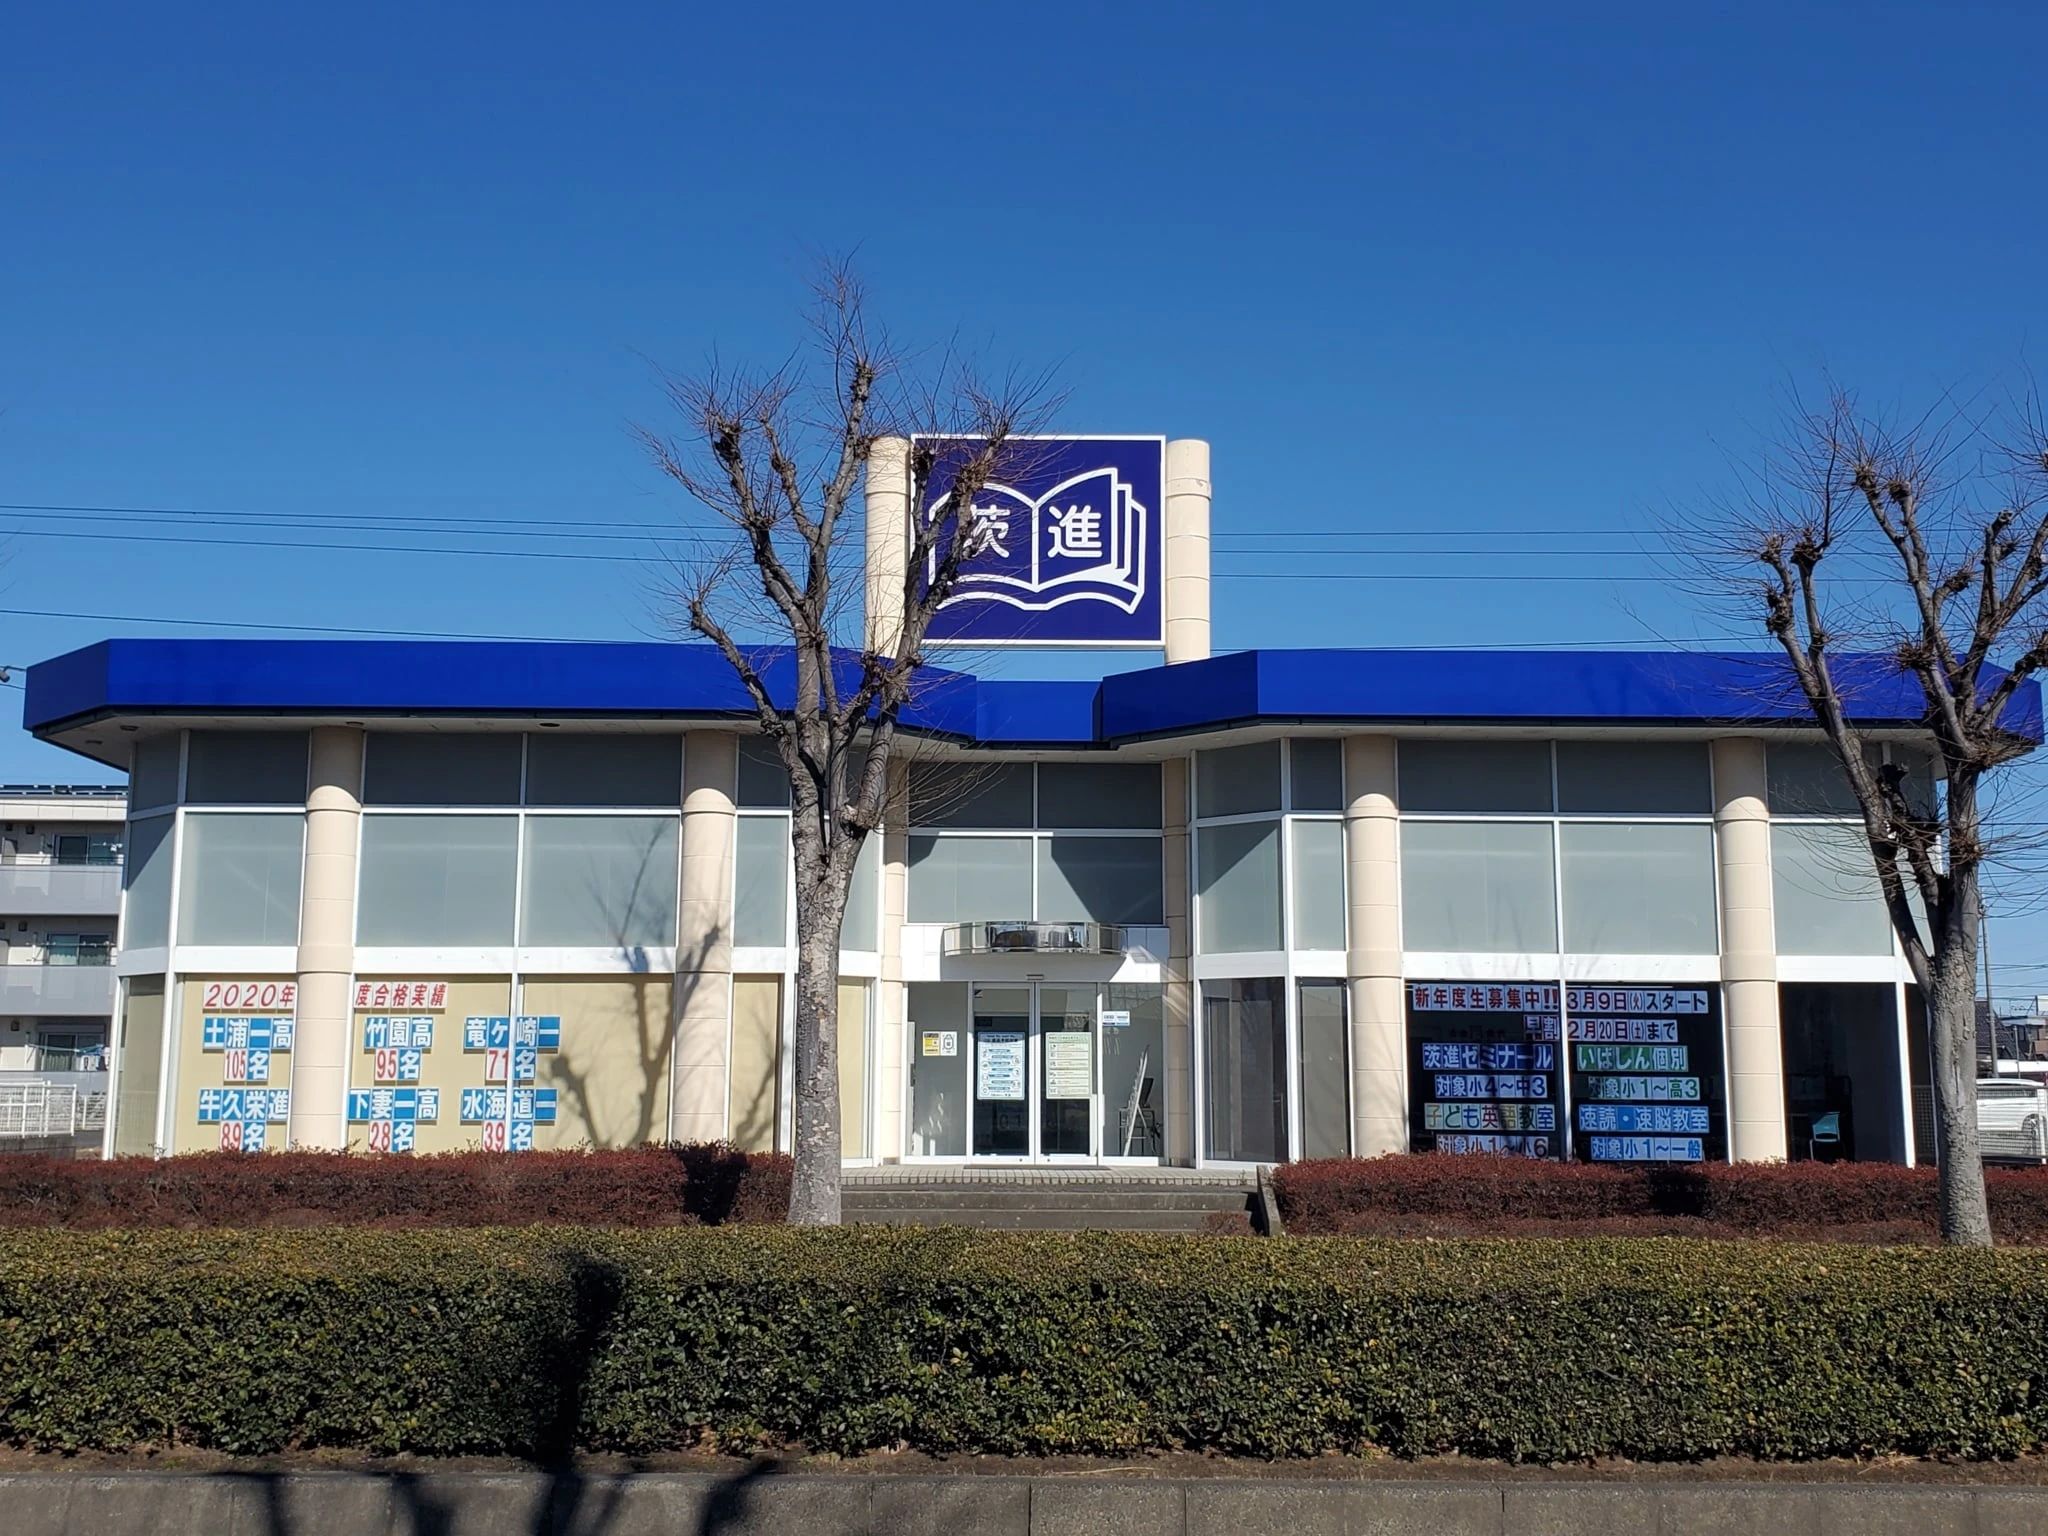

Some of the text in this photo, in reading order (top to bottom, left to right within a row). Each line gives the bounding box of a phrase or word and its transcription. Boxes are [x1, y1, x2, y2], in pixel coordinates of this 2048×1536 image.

[963, 504, 1102, 558] 茨進
[205, 984, 446, 1007] 2020年 度合格実績
[205, 1018, 292, 1048] 土浦一高
[367, 1018, 433, 1047] 竹園高
[1526, 1016, 1560, 1041] 早割
[226, 1050, 268, 1079] 105名
[376, 1050, 419, 1079] 95名
[489, 1049, 535, 1079] 71名
[1424, 1045, 1552, 1069] 茨進ゼミナール
[1580, 1046, 1686, 1070] いばしん個別
[200, 1090, 288, 1119] 牛久栄進
[350, 1090, 437, 1119] 下妻一高
[463, 1090, 555, 1119] 水海道一
[1426, 1104, 1553, 1129] 子ども英語教室
[1580, 1107, 1708, 1132] 速読・速脳教室
[221, 1122, 263, 1150] 89名
[371, 1122, 413, 1151] 28名
[484, 1122, 532, 1150] 39名
